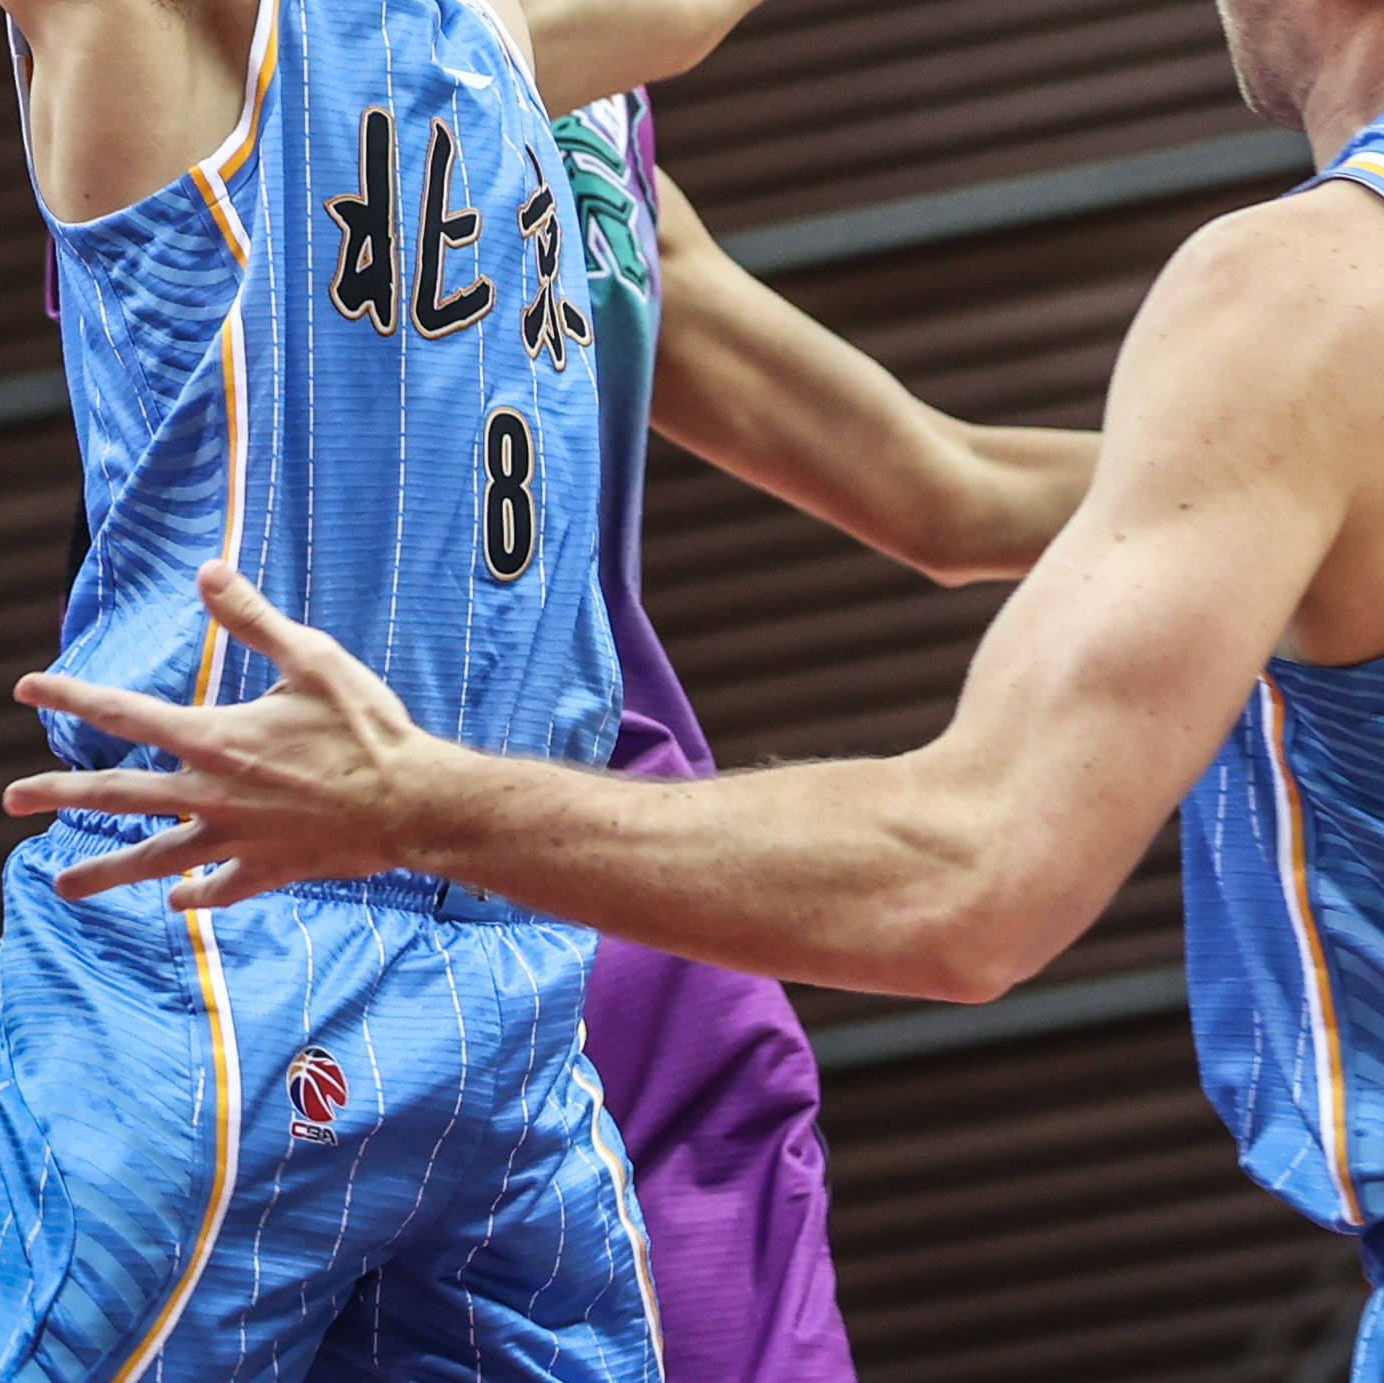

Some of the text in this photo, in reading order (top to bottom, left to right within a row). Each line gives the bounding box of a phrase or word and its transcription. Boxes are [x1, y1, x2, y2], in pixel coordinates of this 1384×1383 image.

[323, 105, 594, 372] 北京
[483, 406, 536, 581] 8
[289, 1120, 338, 1147] CBA
